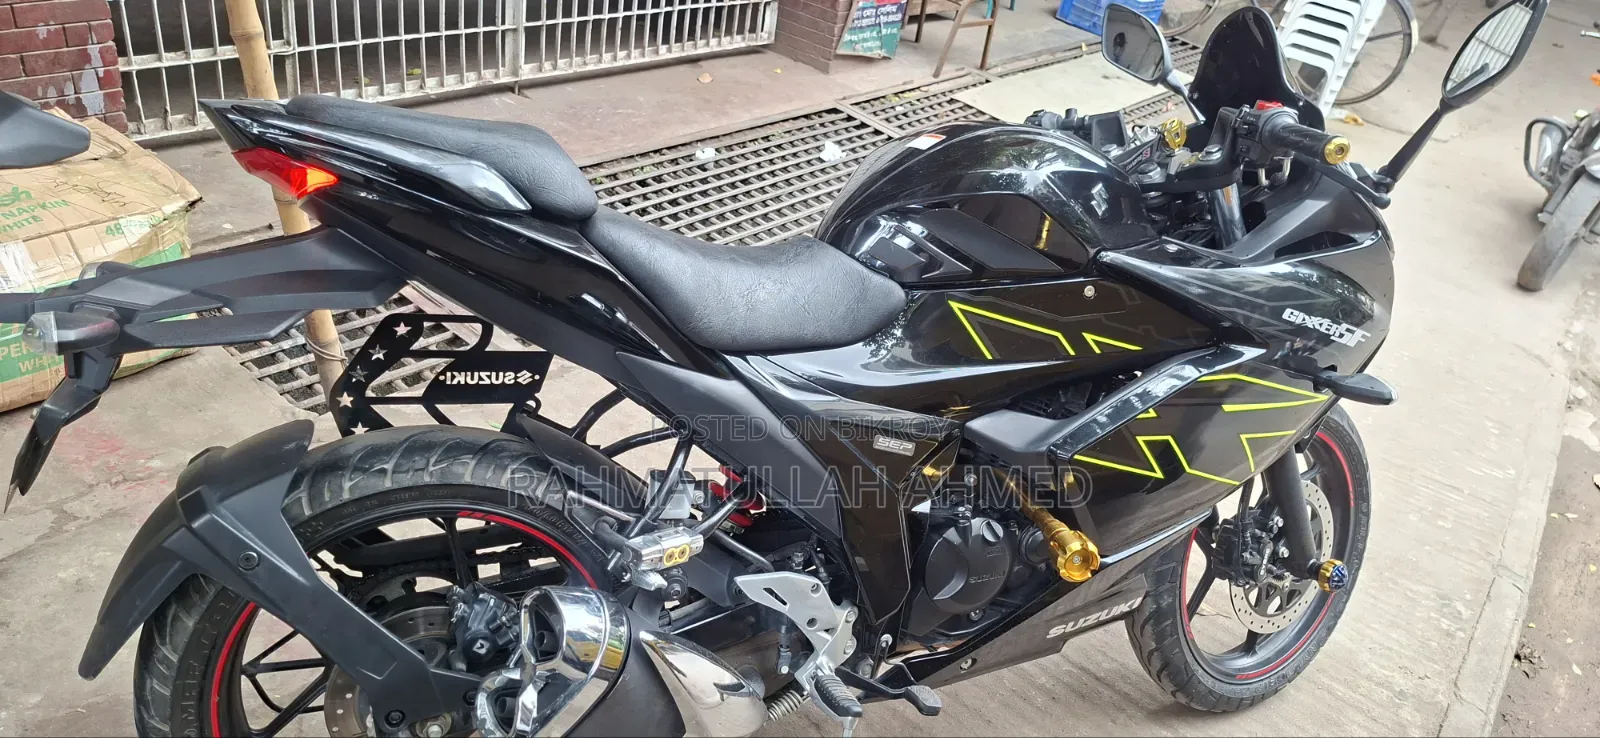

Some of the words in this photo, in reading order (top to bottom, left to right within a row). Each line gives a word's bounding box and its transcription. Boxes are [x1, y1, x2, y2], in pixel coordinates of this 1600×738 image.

[1, 199, 69, 220] NAPKIN
[877, 437, 912, 449] SEP
[1046, 597, 1143, 638] SUZUKI
